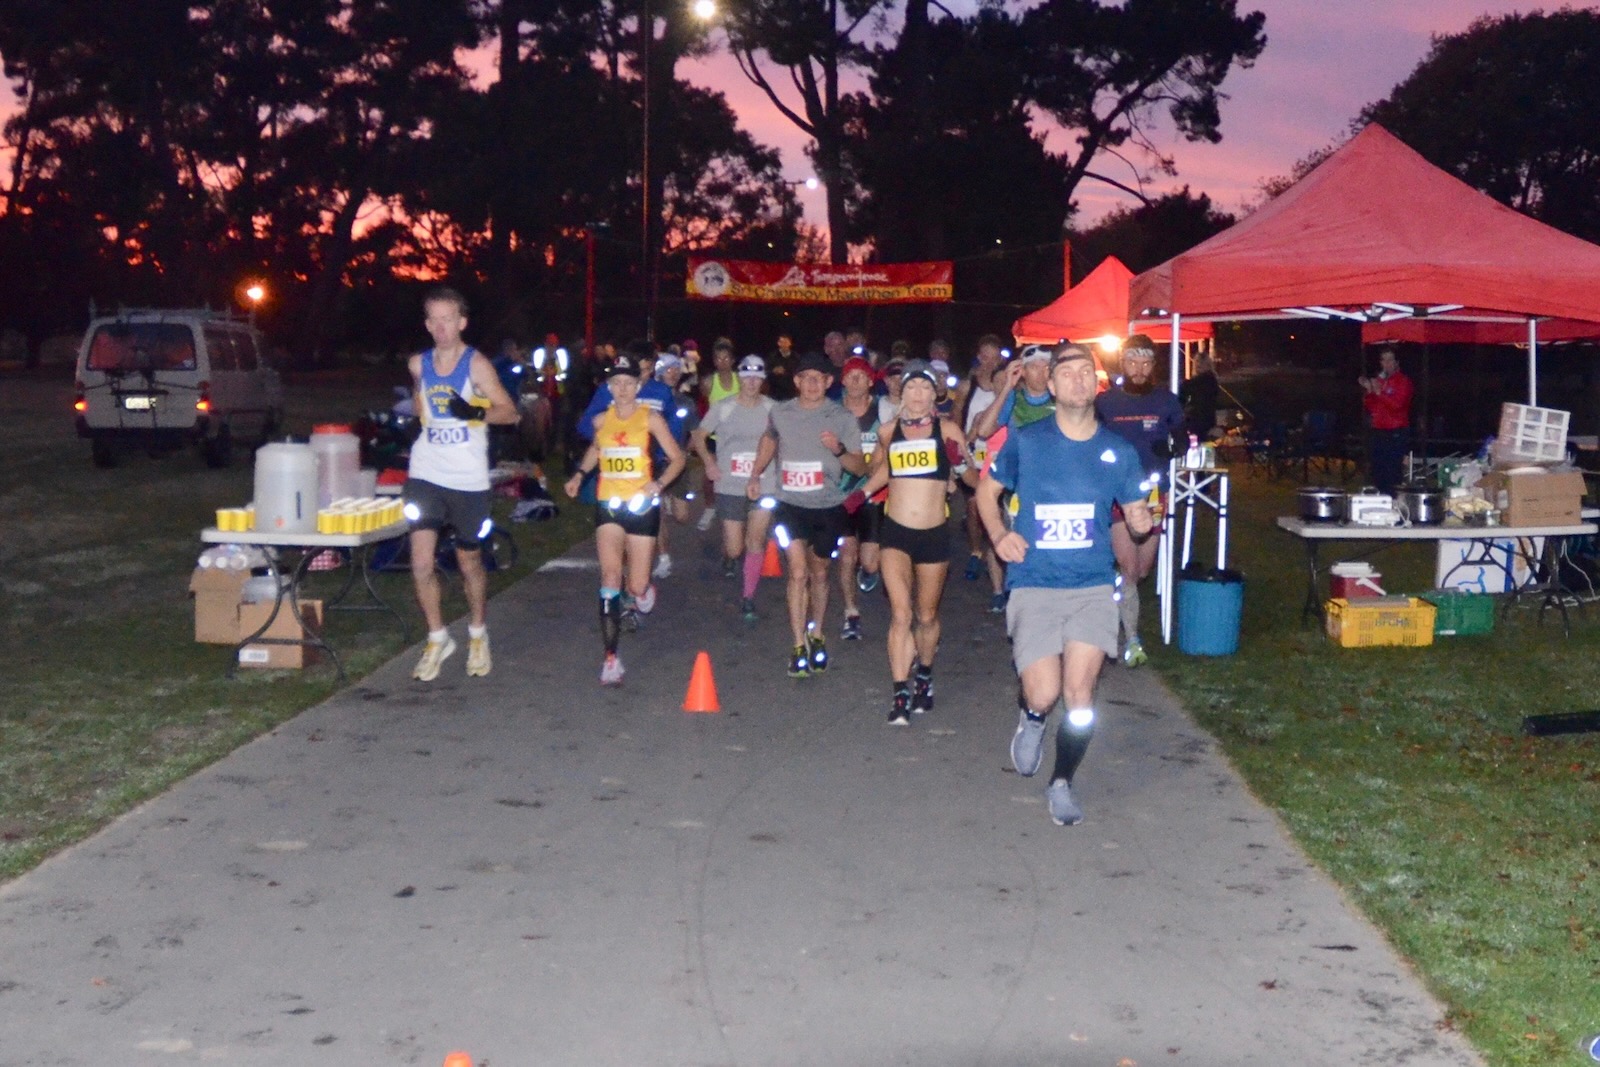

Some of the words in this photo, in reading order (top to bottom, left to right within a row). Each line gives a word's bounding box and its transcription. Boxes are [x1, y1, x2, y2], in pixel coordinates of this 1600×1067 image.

[755, 284, 820, 300] Chinmoy
[826, 285, 901, 299] Marathon
[907, 284, 948, 297] Team
[430, 428, 464, 444] 200
[607, 457, 635, 472] 103
[735, 460, 754, 472] 50
[896, 451, 929, 468] 108
[786, 471, 815, 487] 501
[1043, 518, 1087, 541] 203
